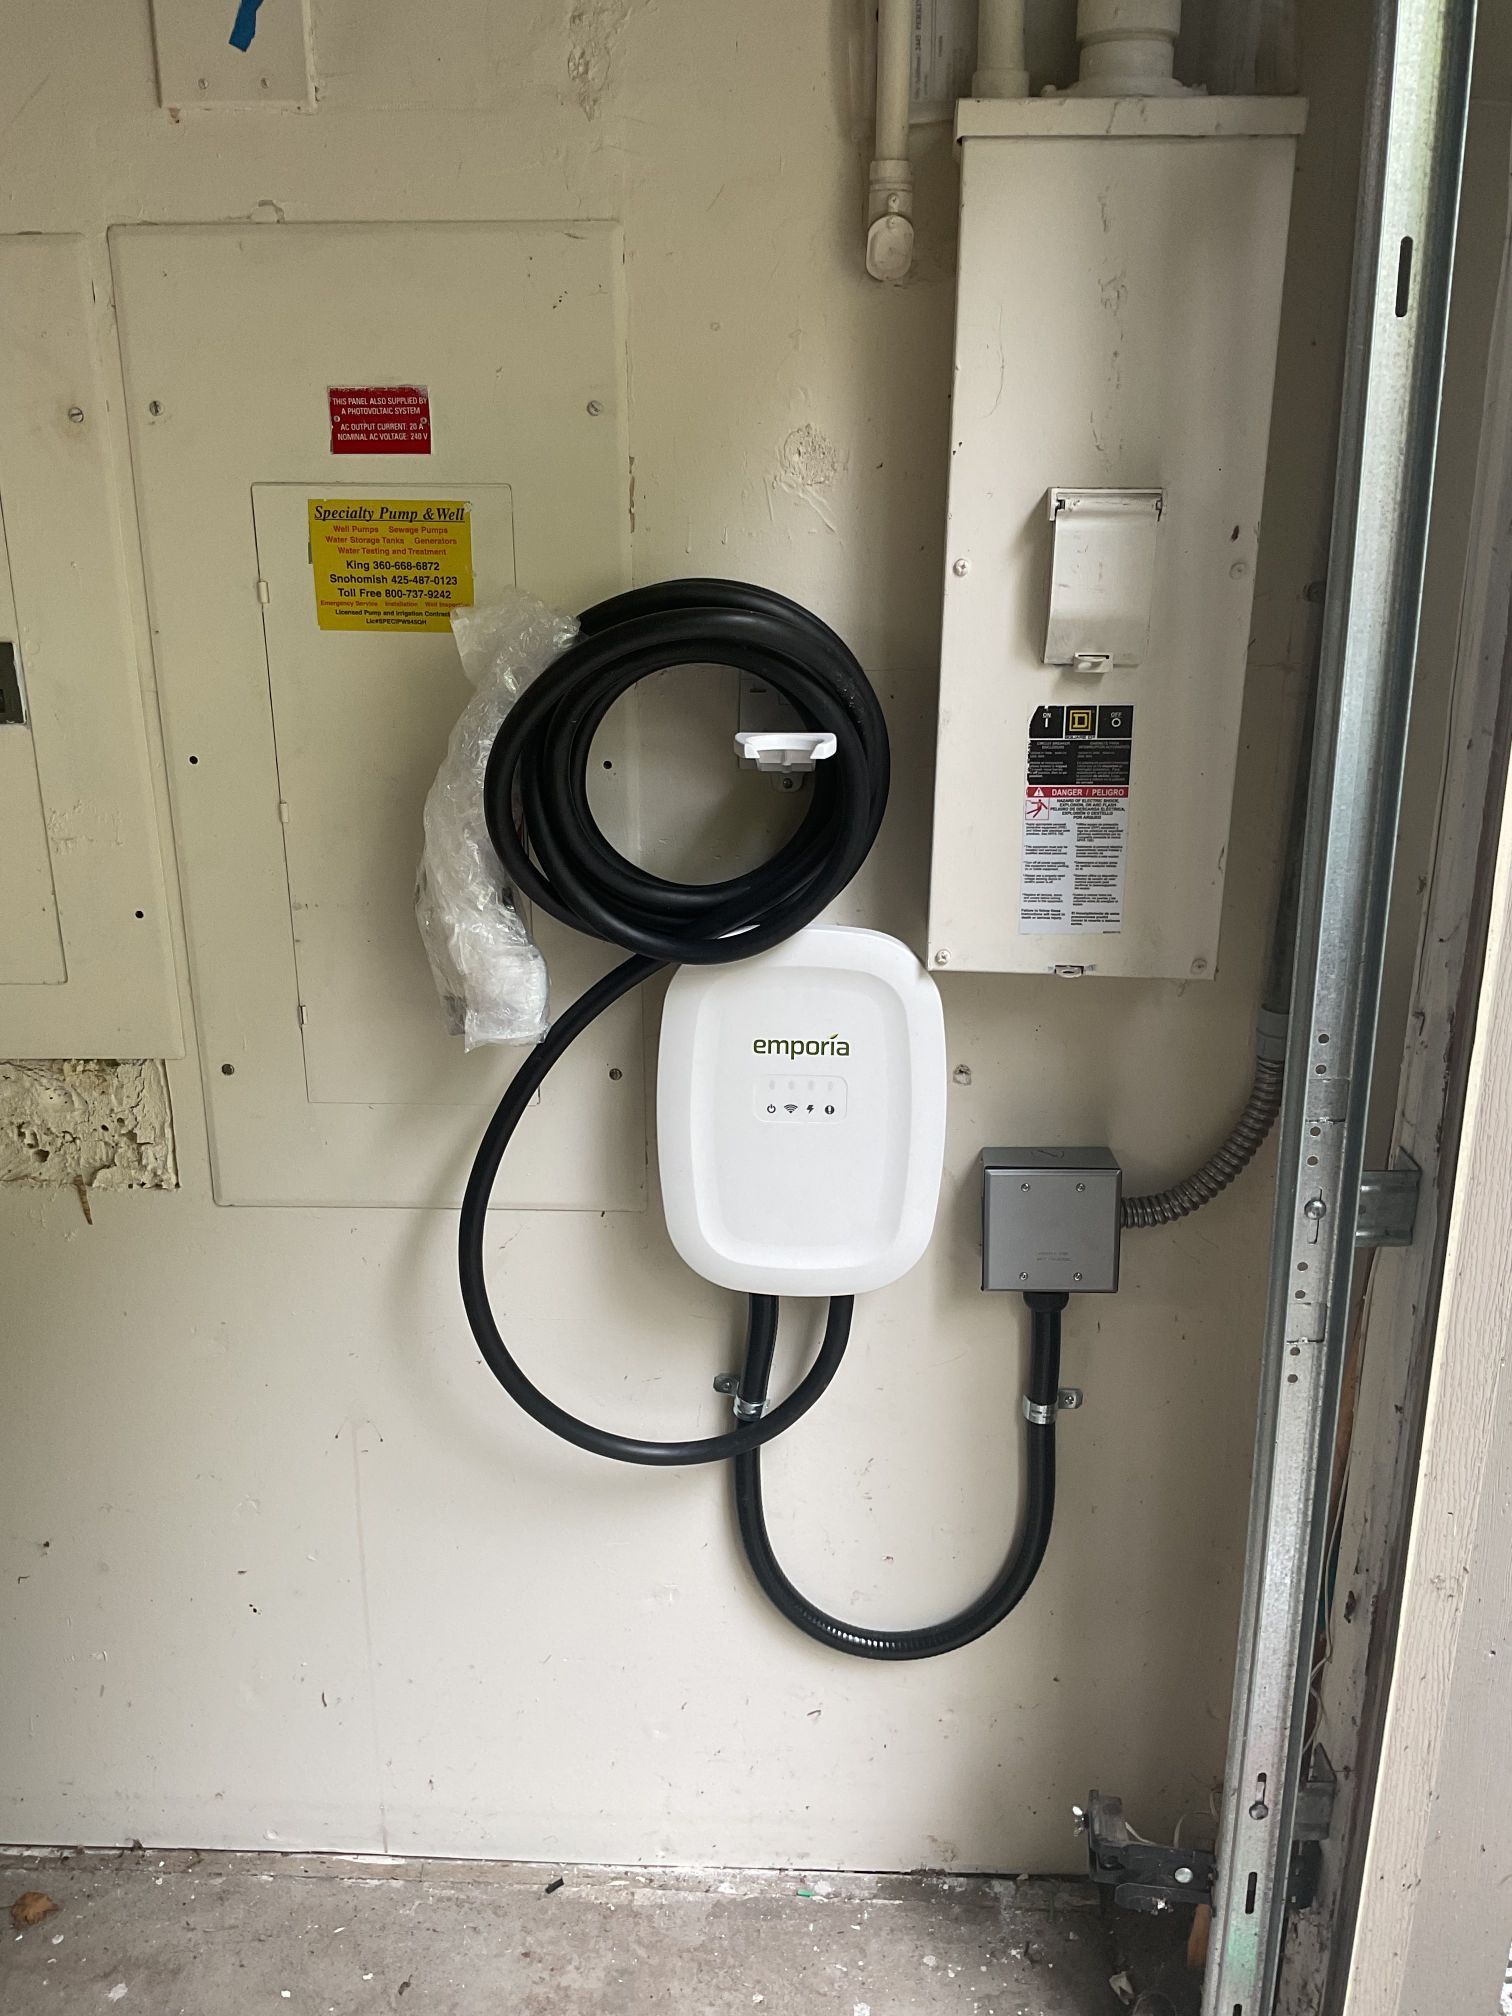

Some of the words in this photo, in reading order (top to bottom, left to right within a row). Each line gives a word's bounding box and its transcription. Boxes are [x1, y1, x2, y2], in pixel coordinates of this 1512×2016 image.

[314, 506, 374, 522] Specialty
[379, 507, 418, 523] Pump
[352, 526, 379, 534] Pumps
[388, 526, 419, 535] Sewage
[421, 527, 448, 535] Pumps
[350, 536, 380, 546] Storage
[362, 547, 390, 556] Testing
[346, 560, 370, 571] King
[373, 561, 440, 571] 360-668-6872
[330, 574, 388, 584] Snohomish
[391, 576, 458, 585] 425-487-0123
[338, 588, 356, 597] Toll
[360, 589, 382, 597] Free
[385, 590, 452, 599] 800-737-9242
